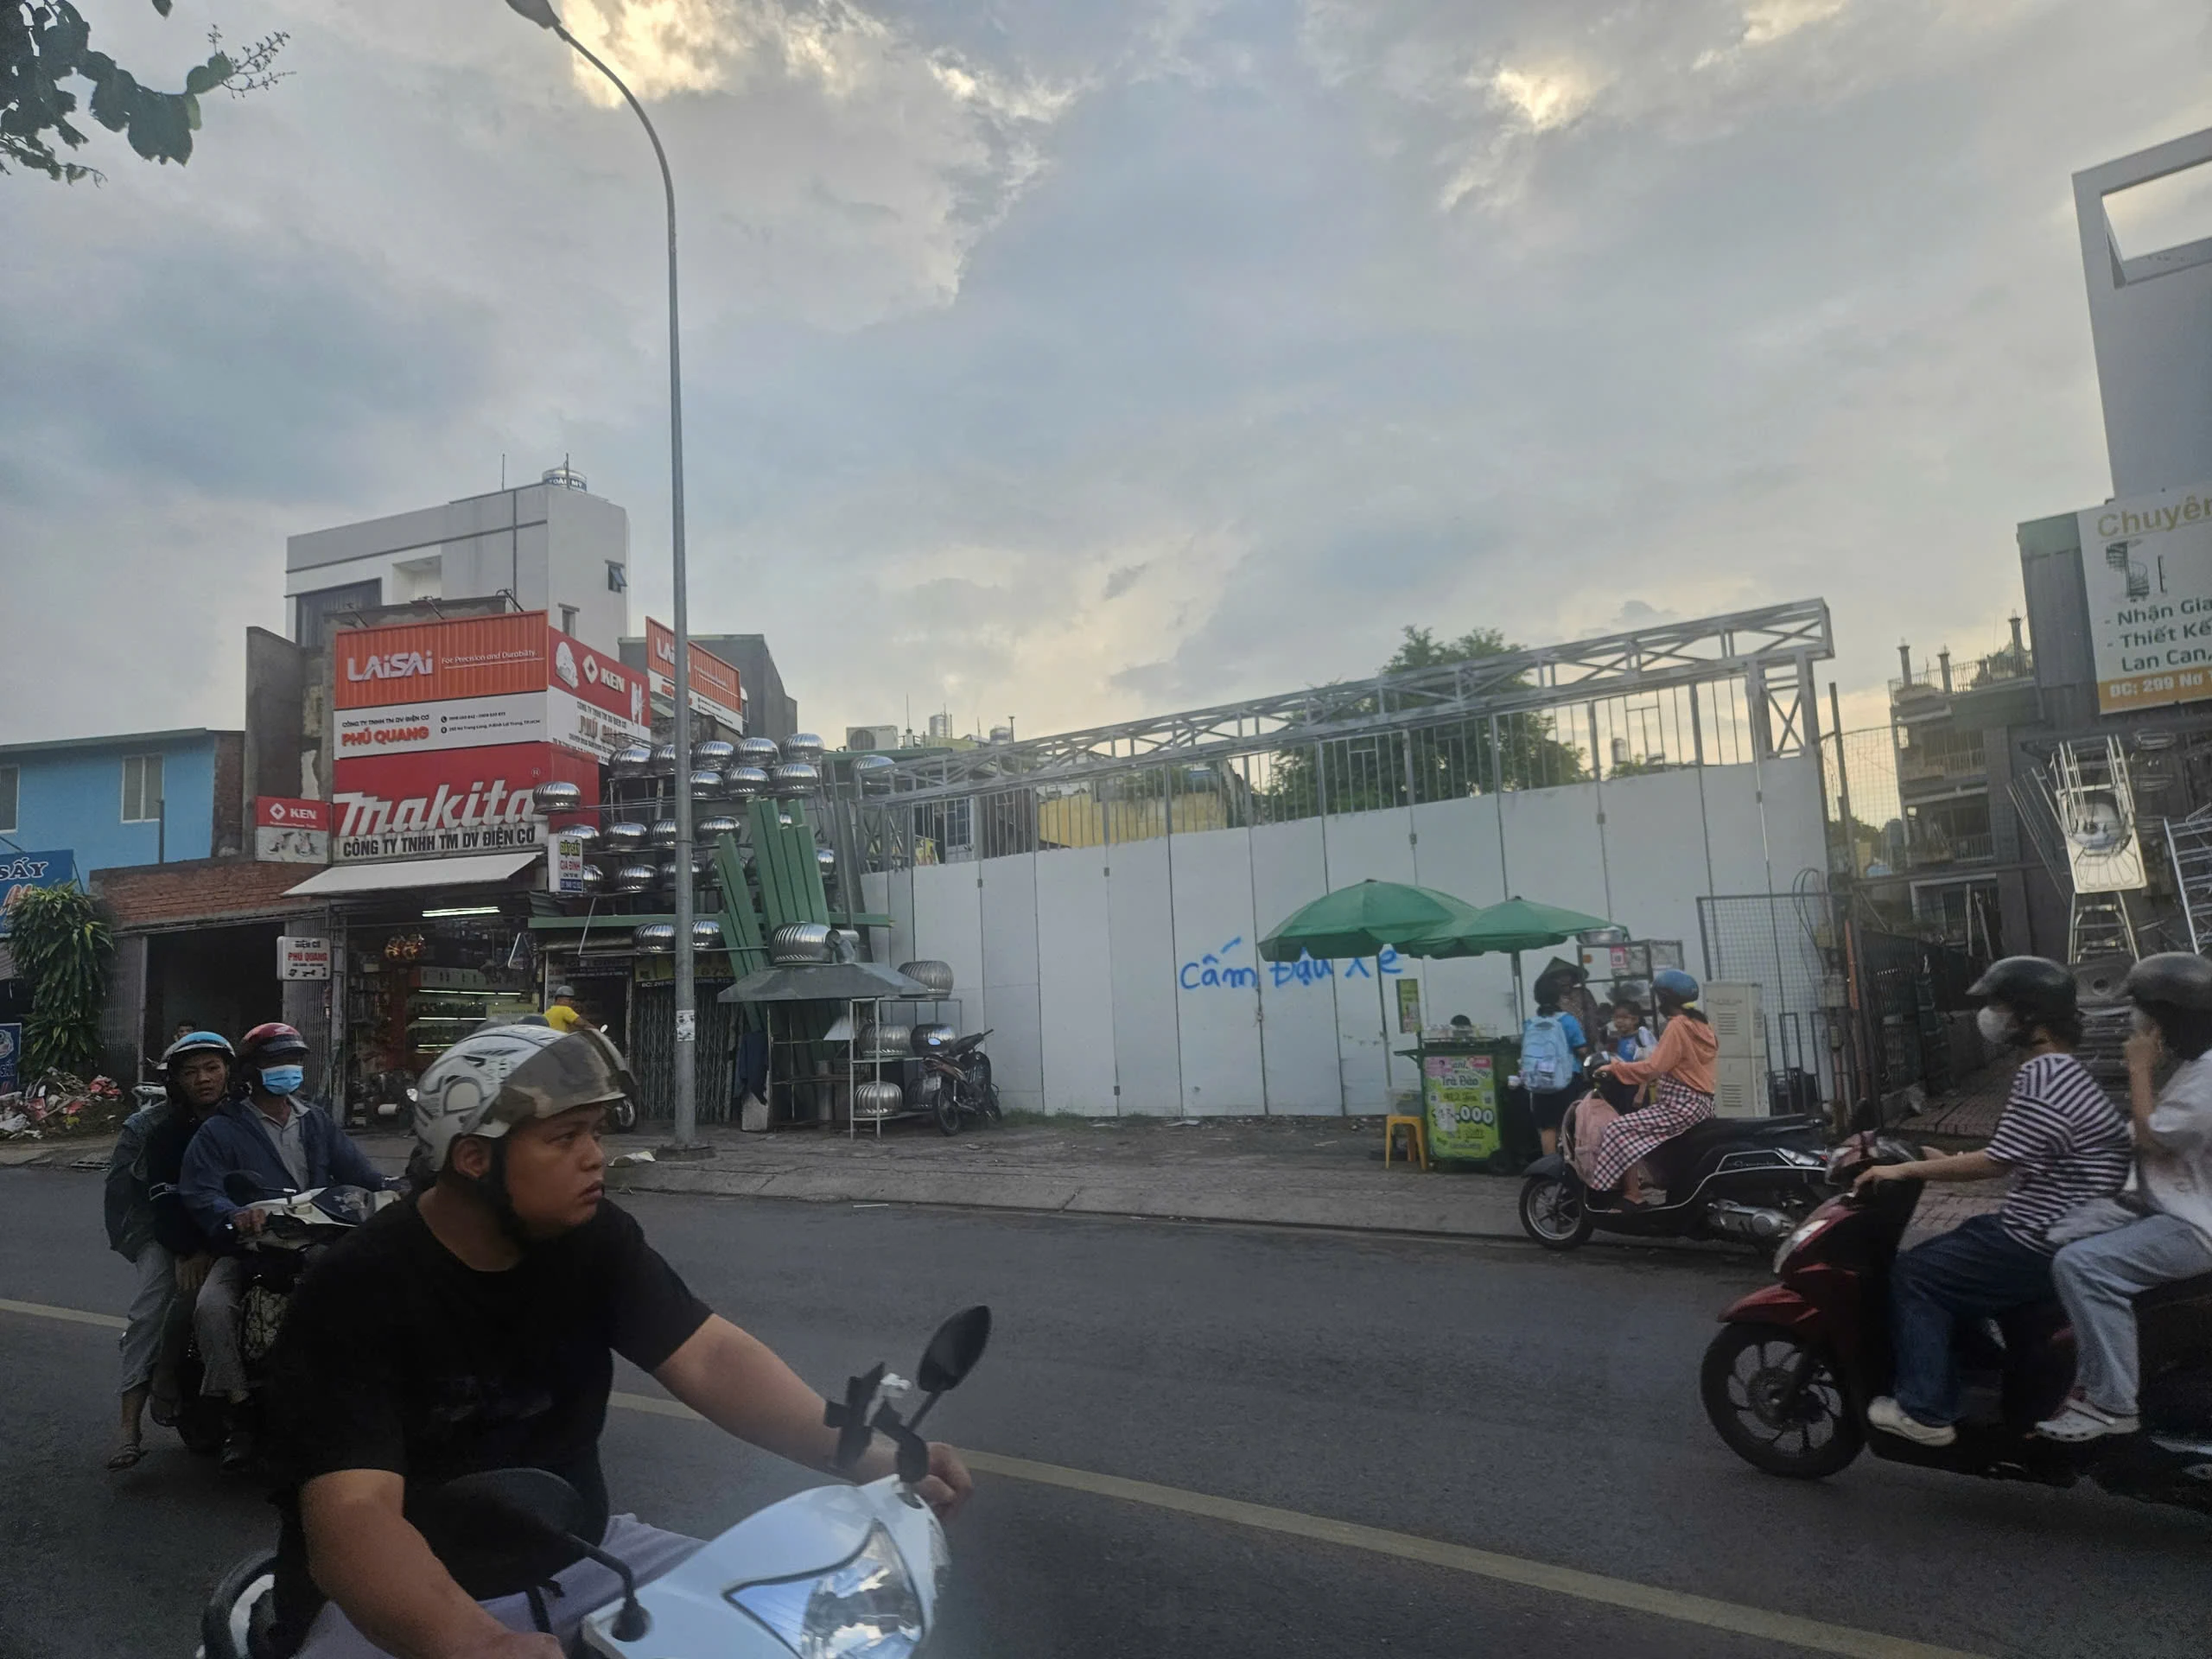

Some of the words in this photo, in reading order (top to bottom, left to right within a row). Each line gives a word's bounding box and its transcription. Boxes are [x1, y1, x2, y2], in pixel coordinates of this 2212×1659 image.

[2117, 604, 2173, 626] Nhận
[2120, 624, 2177, 648] Thiết
[2183, 616, 2212, 639] Kế
[455, 655, 485, 664] Precision
[486, 652, 500, 660] and
[2121, 655, 2159, 671] Lan
[601, 667, 625, 692] KEN
[2143, 676, 2175, 692] 299
[341, 727, 372, 747] PHÚ
[373, 726, 429, 745] QUANG
[290, 808, 316, 820] KEN
[343, 837, 378, 857] CÔNG
[382, 839, 397, 854] TY
[401, 835, 435, 852] TNHH
[439, 834, 458, 849] TM
[462, 831, 480, 849] DV
[482, 826, 514, 849] ĐIỆN
[517, 826, 536, 844] CƠ
[0, 857, 48, 880] SẤY
[1180, 937, 1258, 989] Cấm
